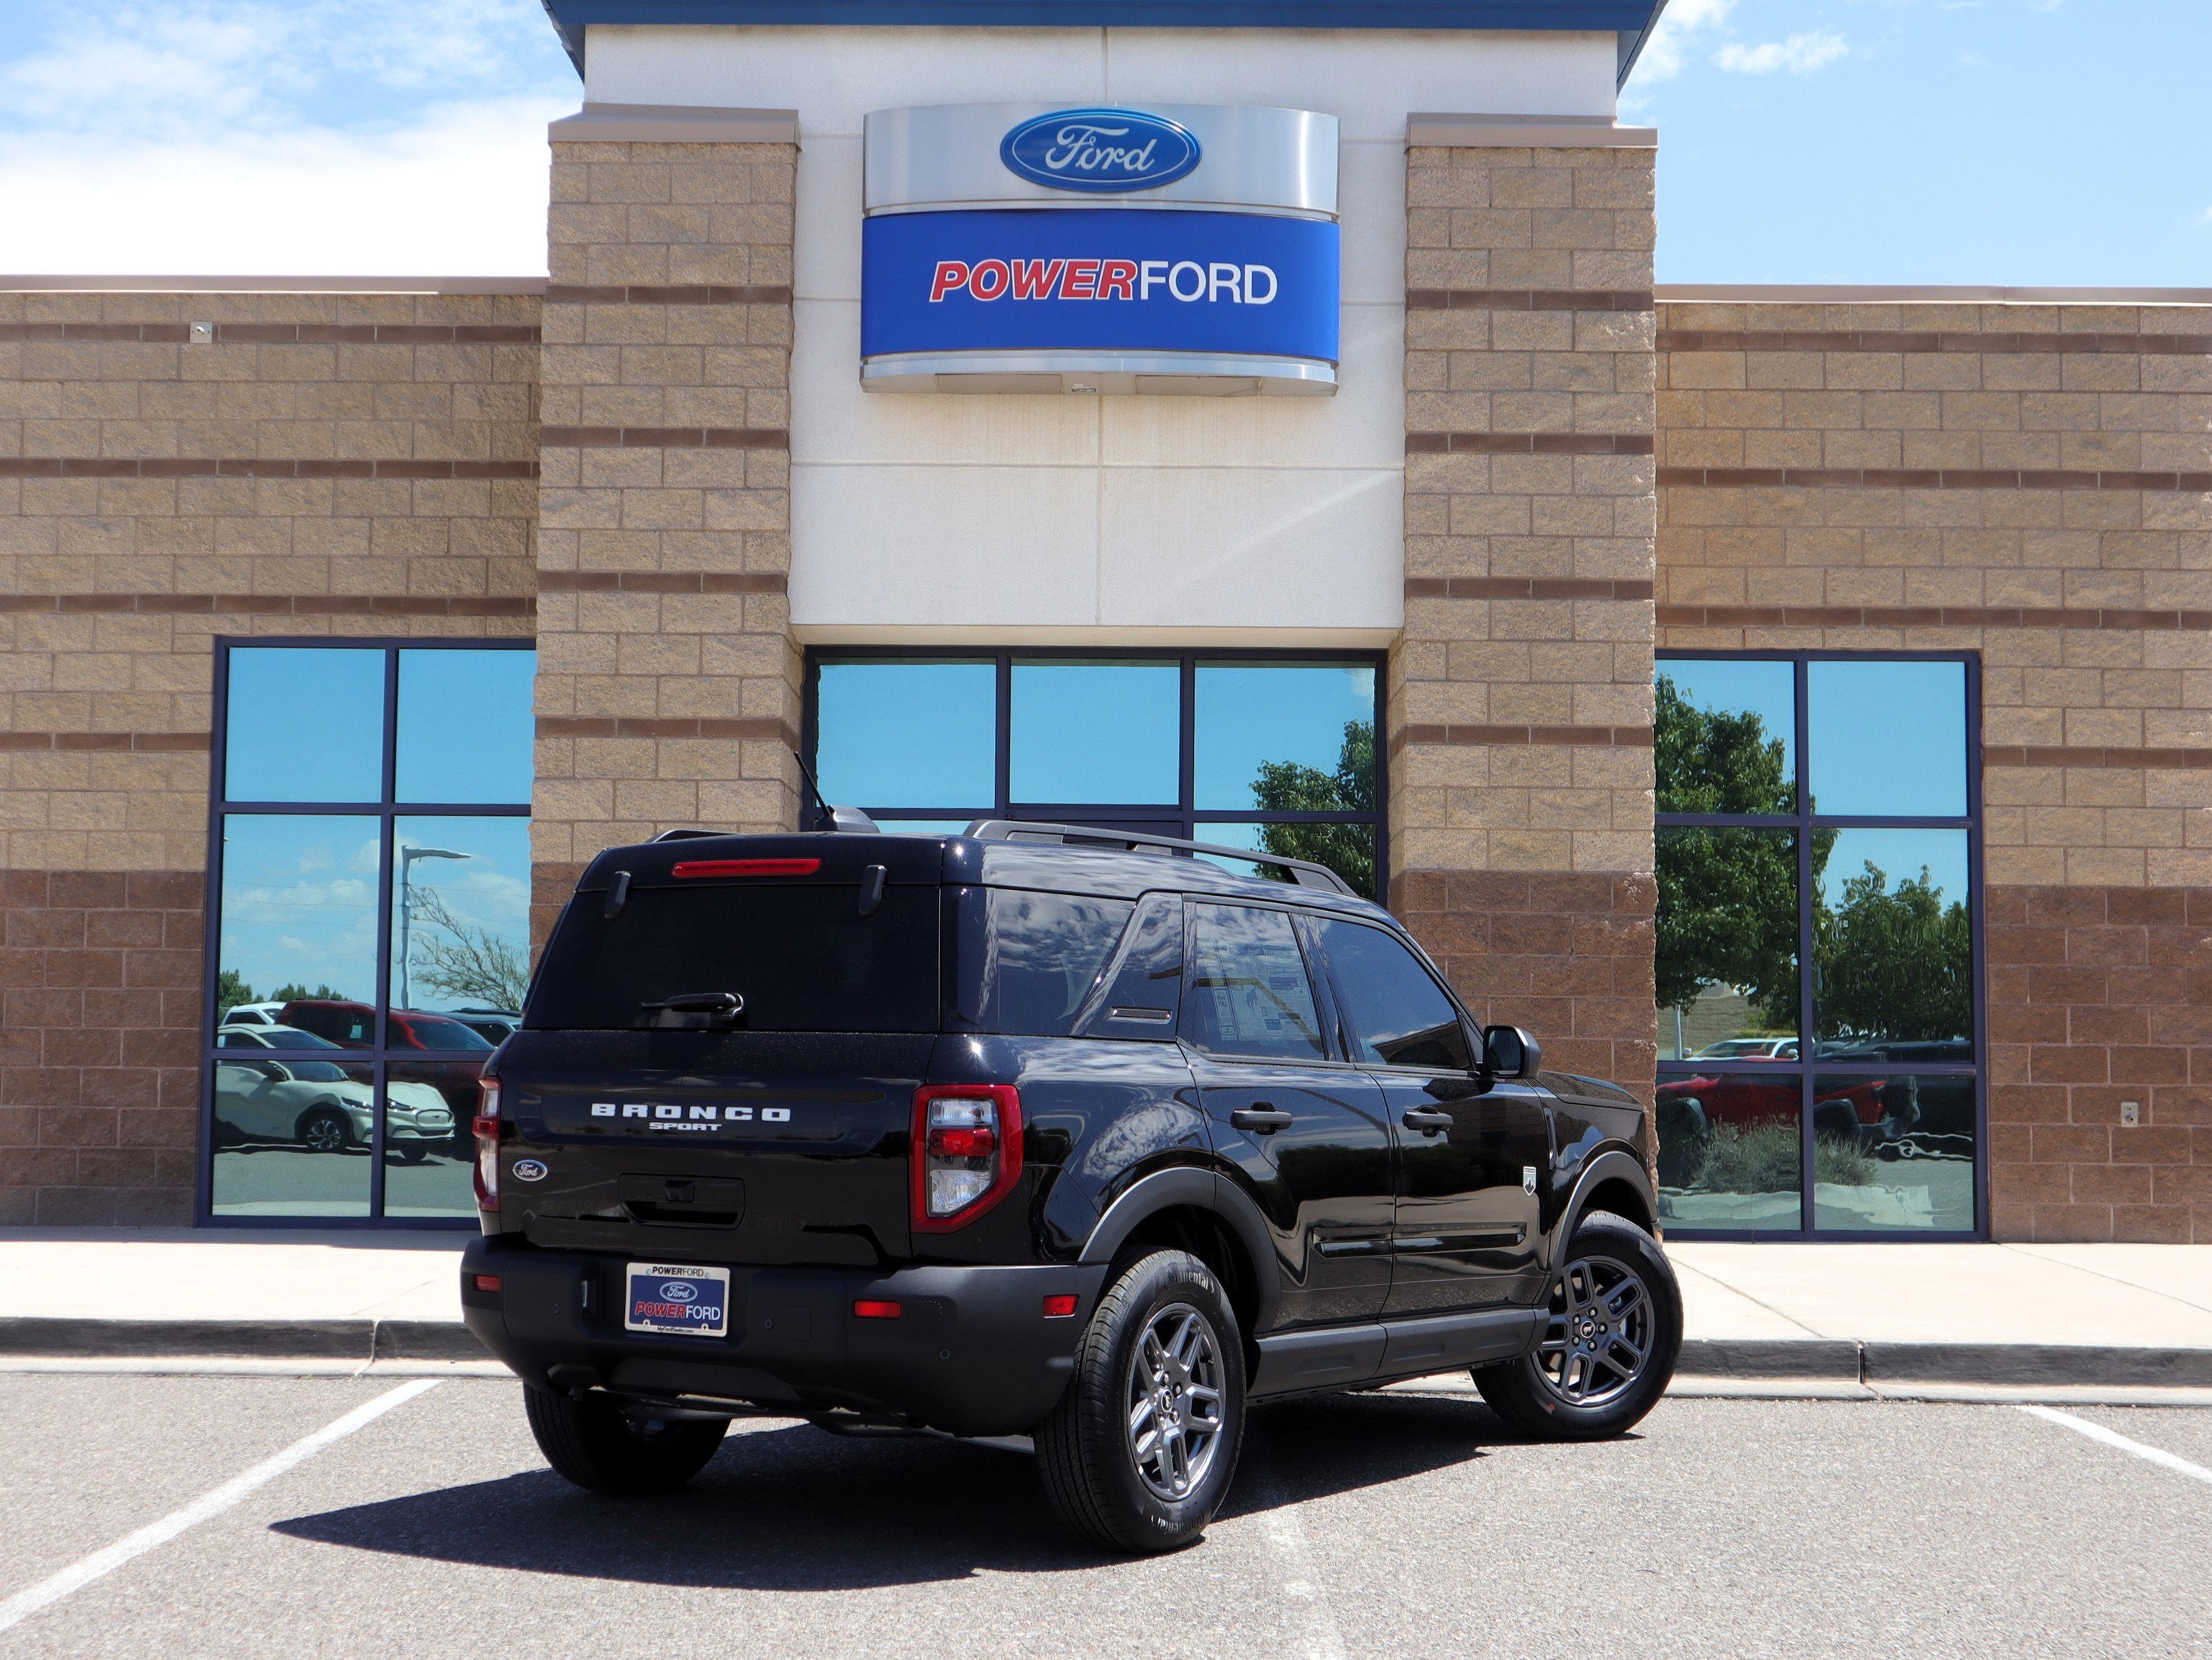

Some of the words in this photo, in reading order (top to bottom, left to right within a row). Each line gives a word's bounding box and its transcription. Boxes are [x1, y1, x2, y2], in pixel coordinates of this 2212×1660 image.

[1045, 124, 1157, 171] Ford
[929, 258, 1278, 305] POWERFORD
[591, 1102, 791, 1122] BRONCO
[649, 1122, 722, 1132] SPORT
[519, 1164, 539, 1176] Ford
[652, 1266, 704, 1277] POWERFORD
[667, 1285, 691, 1298] Ford
[634, 1301, 720, 1321] POWERFORD
